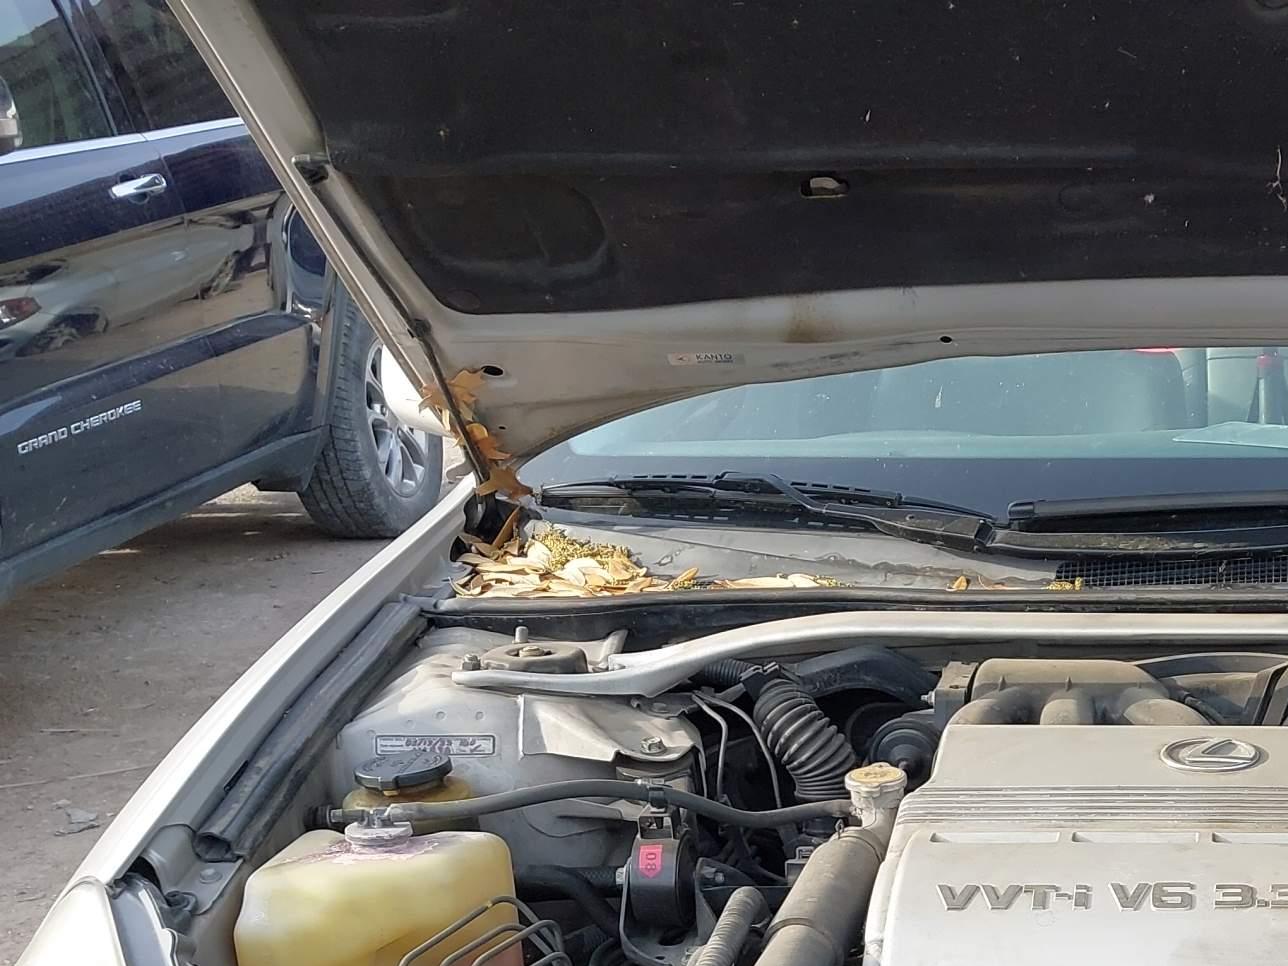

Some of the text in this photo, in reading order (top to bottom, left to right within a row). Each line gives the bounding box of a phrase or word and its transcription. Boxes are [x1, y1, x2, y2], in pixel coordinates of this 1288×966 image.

[17, 399, 142, 455] GRAND CHEROKEE
[936, 883, 1091, 911] VVT-i
[1107, 882, 1197, 911] V6
